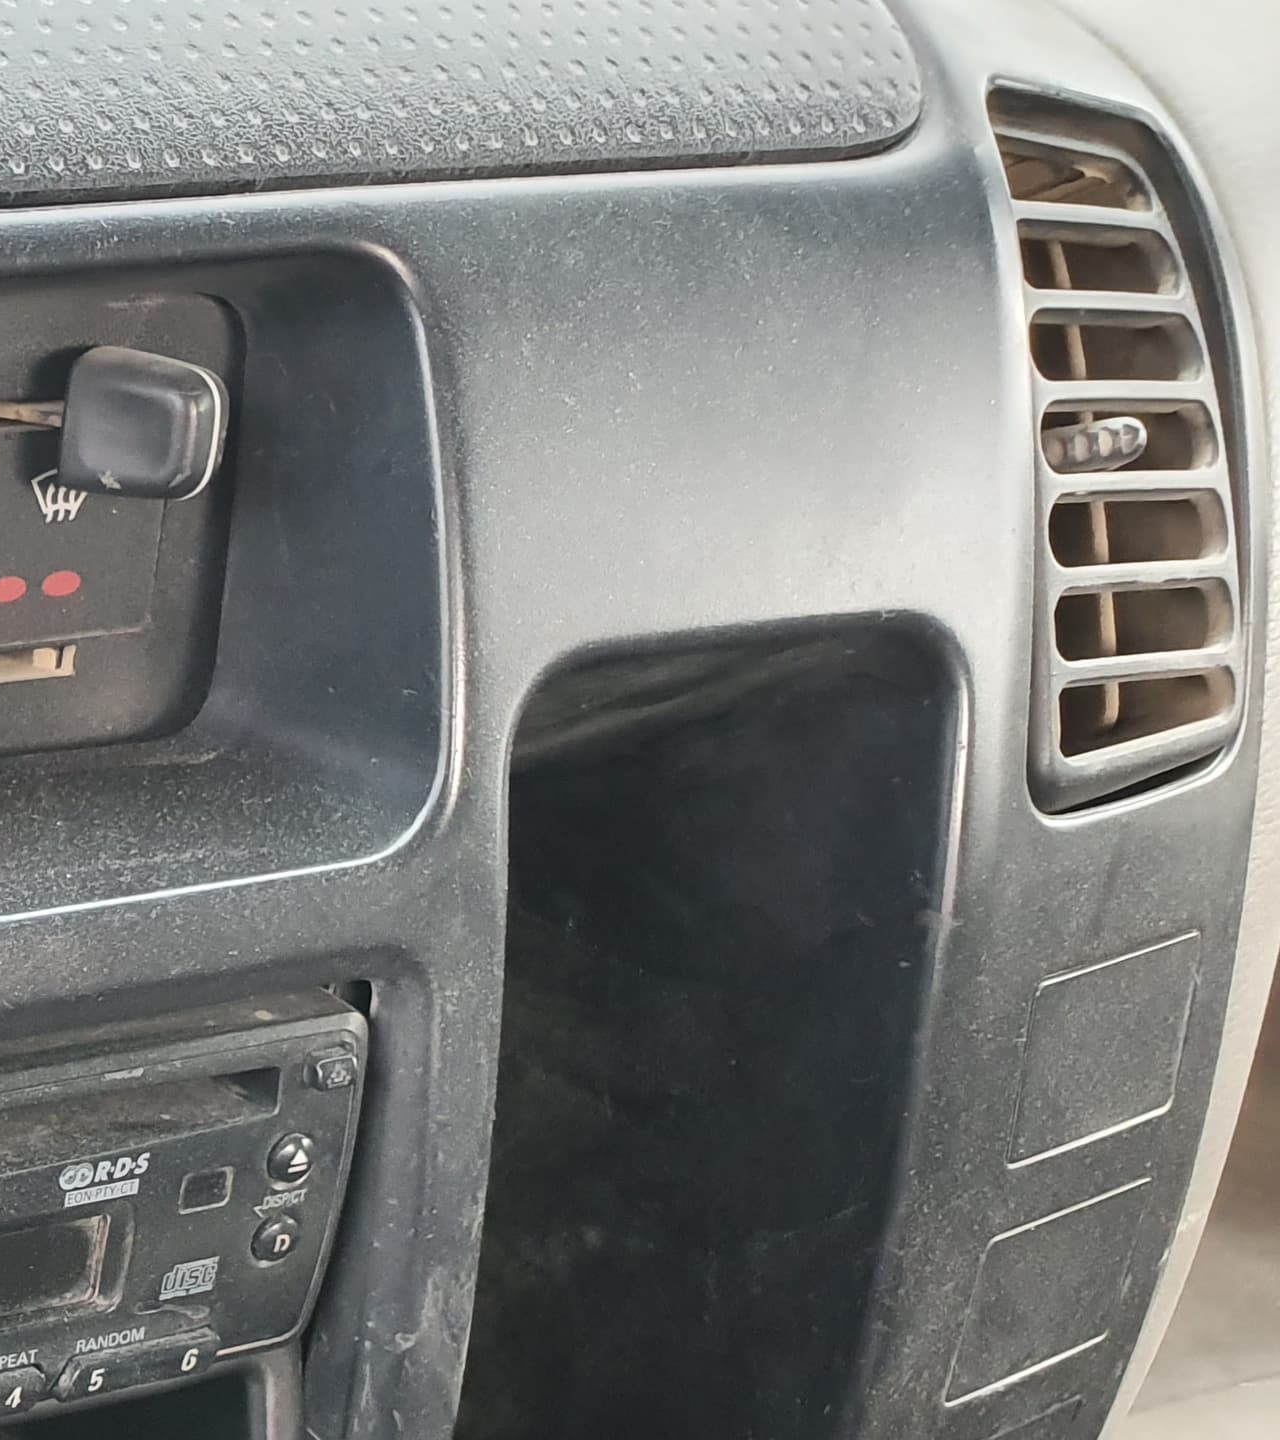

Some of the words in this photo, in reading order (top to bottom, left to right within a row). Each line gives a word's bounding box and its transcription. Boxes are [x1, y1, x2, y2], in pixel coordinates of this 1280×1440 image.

[75, 1327, 146, 1354] RANDOM
[180, 1348, 199, 1372] 6
[88, 1370, 104, 1392] 5
[5, 1386, 23, 1409] 4
